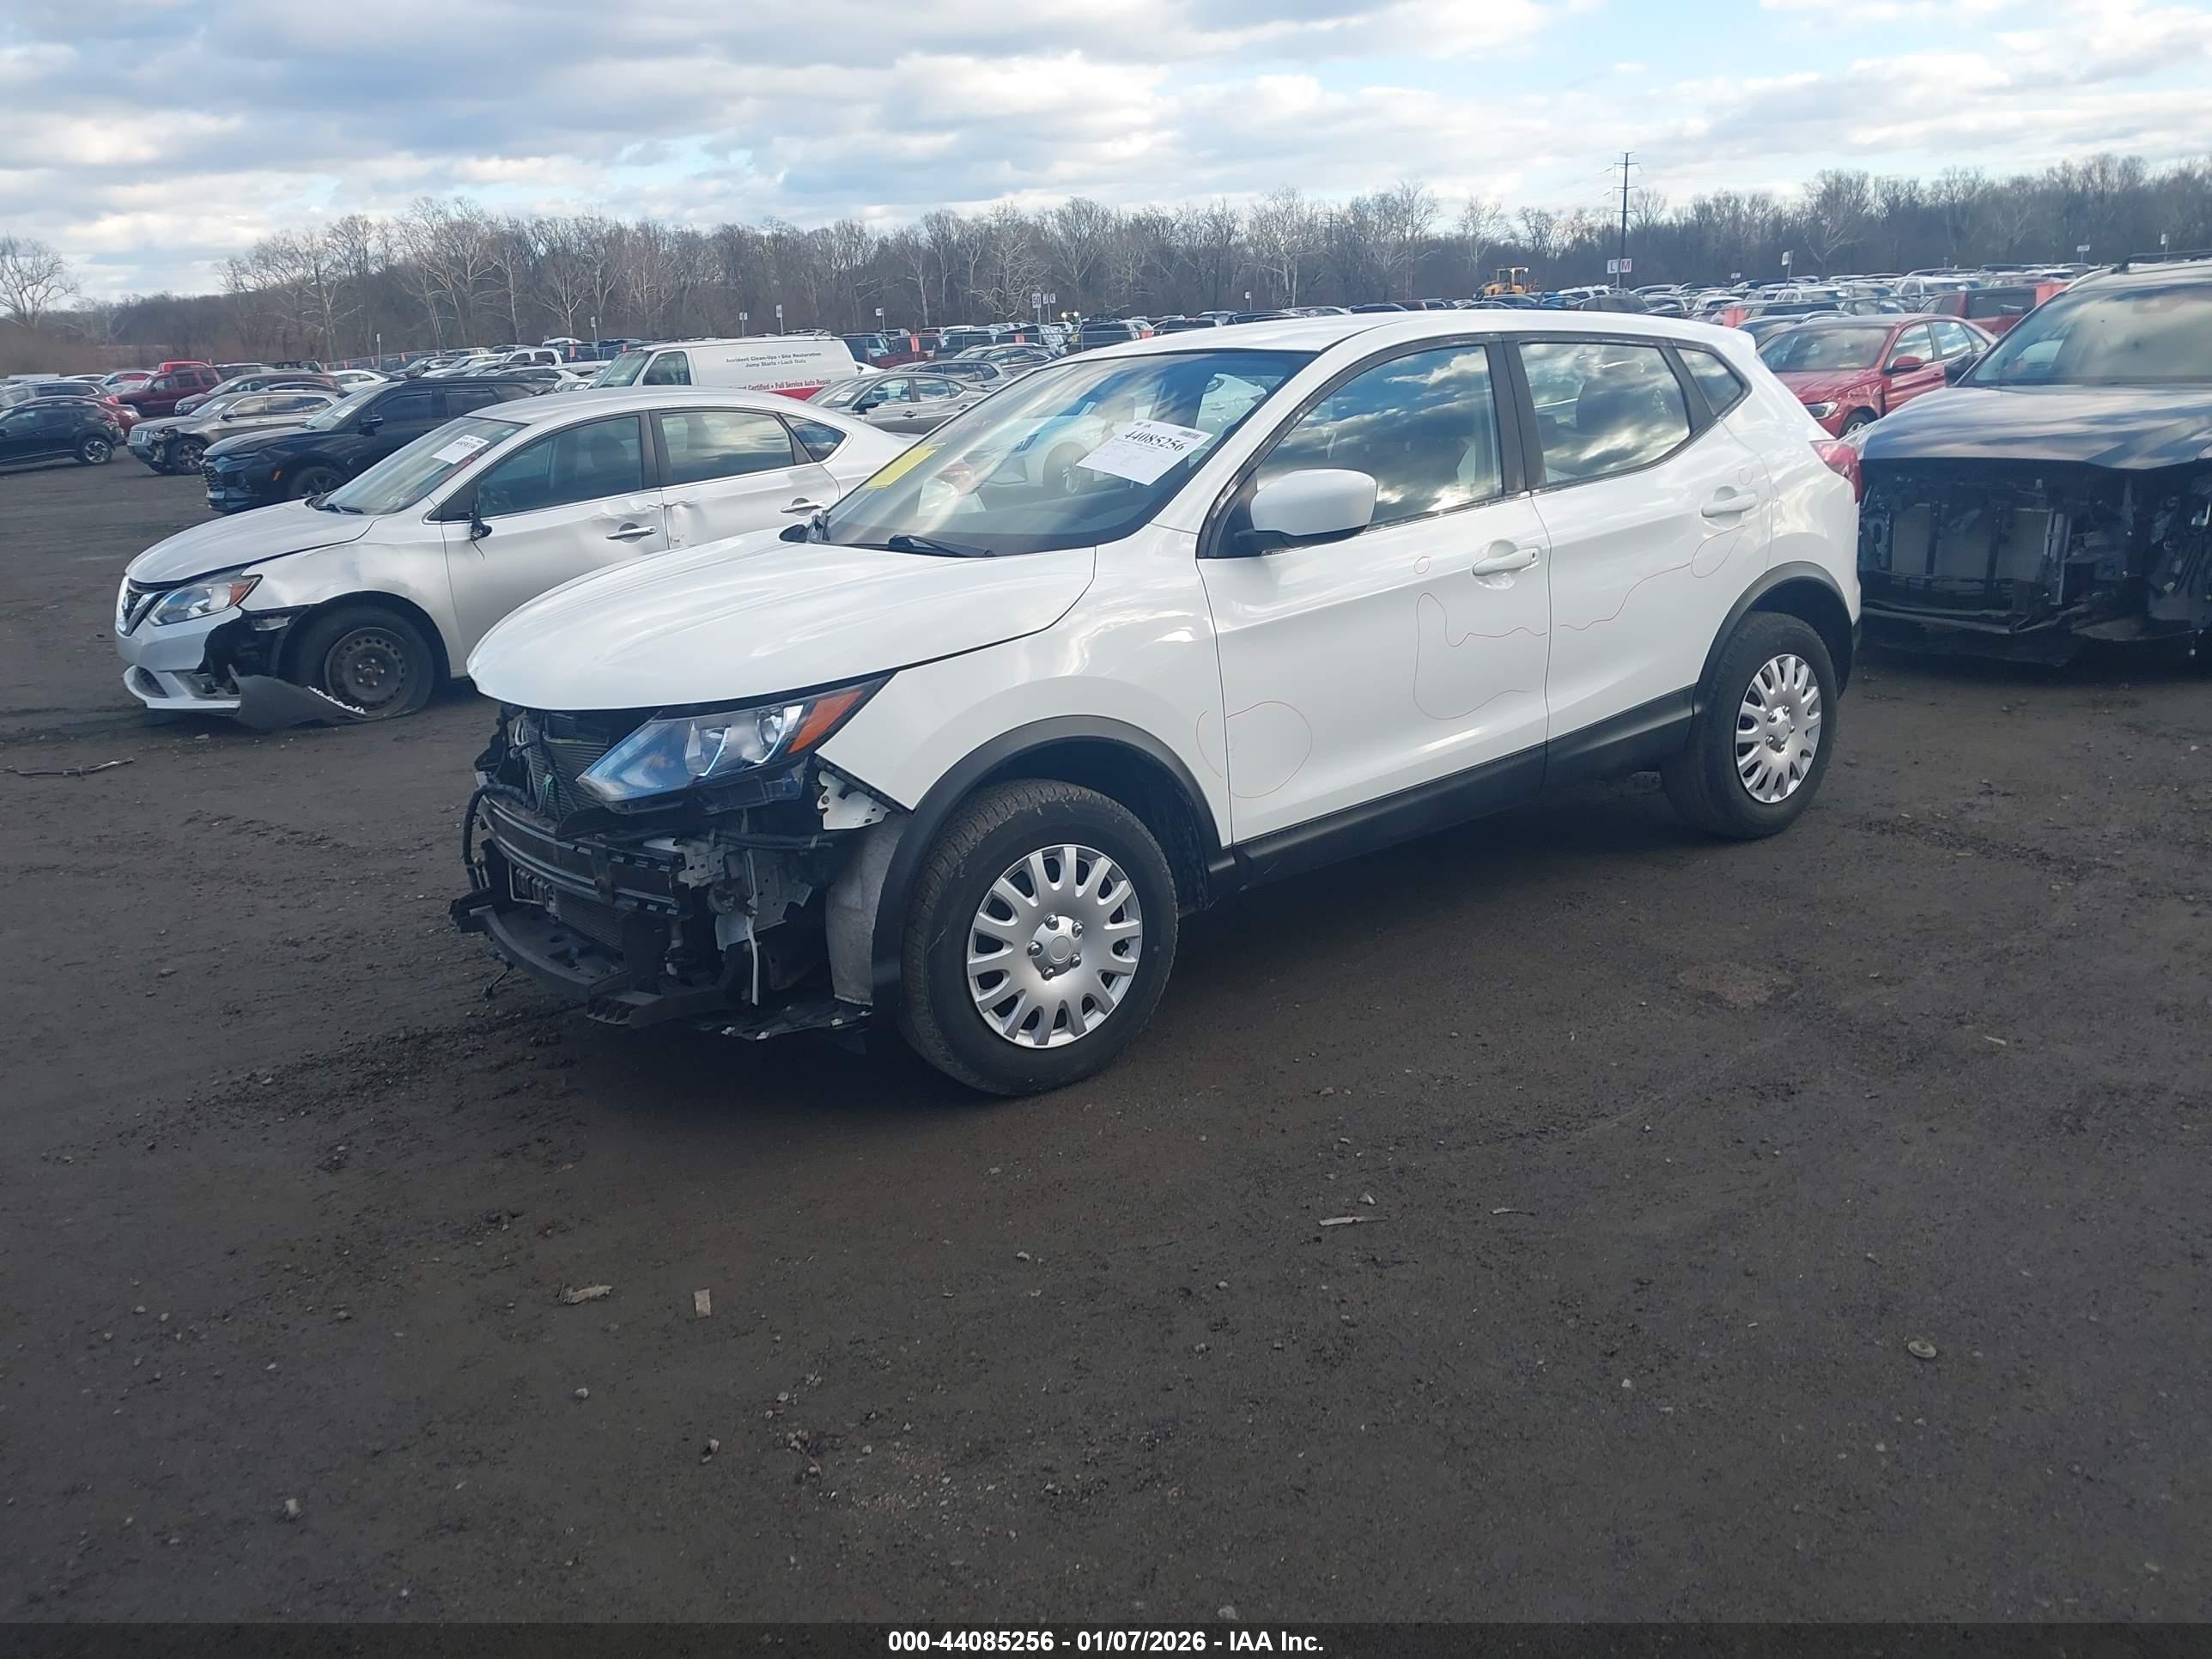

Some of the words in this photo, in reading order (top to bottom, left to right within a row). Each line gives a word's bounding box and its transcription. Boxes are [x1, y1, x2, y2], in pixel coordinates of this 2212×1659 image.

[1621, 259, 1631, 271] M
[1032, 295, 1041, 307] 50
[816, 378, 831, 386] Repair
[1124, 430, 1188, 452] 44085256
